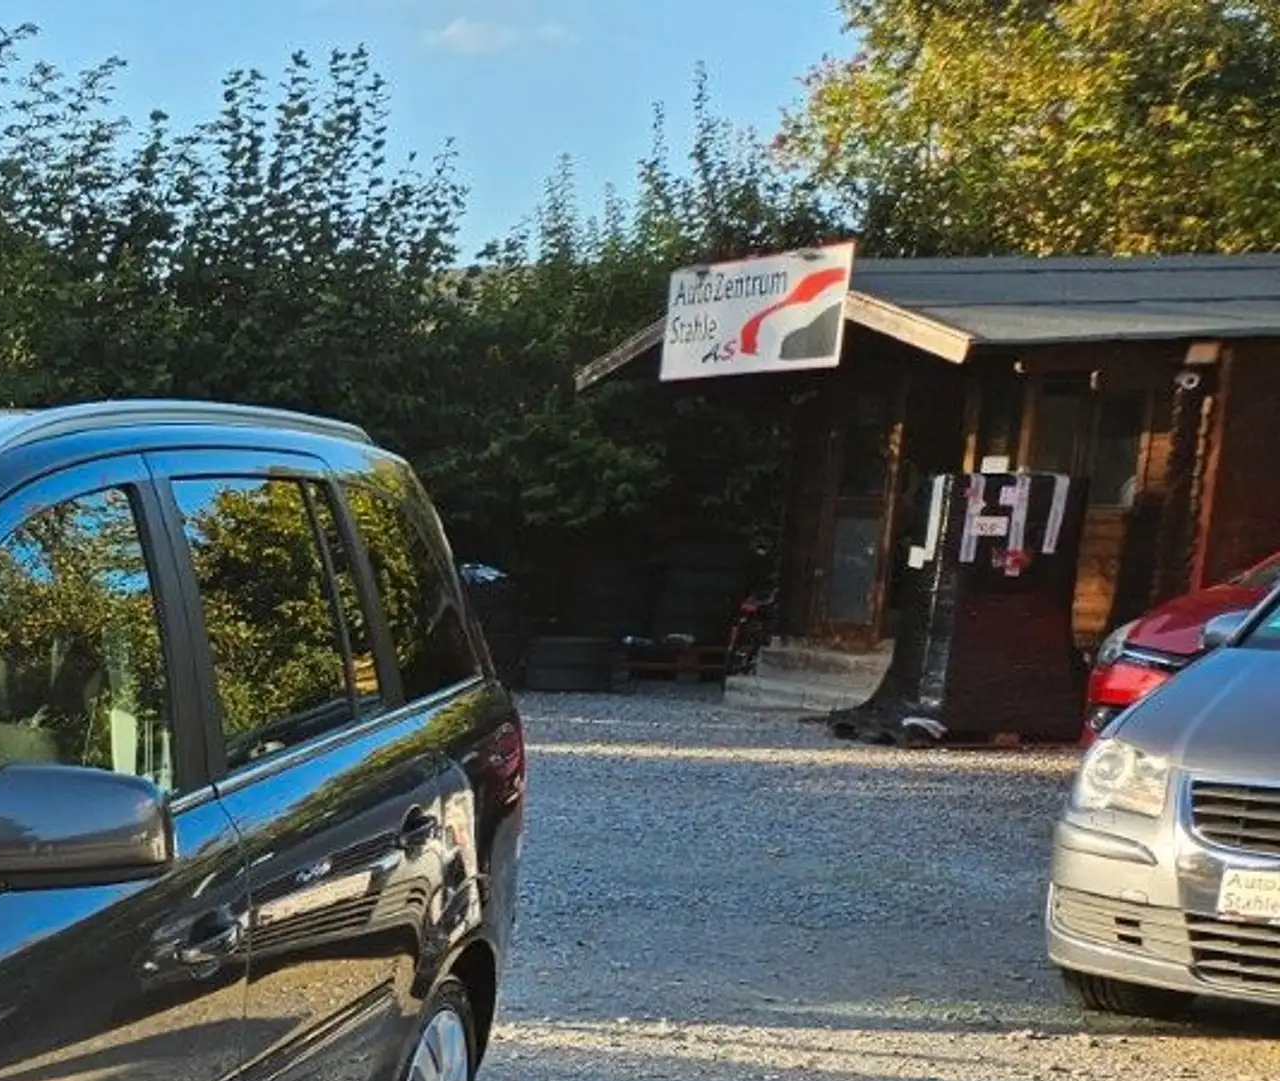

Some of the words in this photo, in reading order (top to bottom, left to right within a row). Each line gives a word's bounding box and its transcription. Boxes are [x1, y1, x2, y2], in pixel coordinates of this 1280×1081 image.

[674, 271, 788, 306] AutoZentrum
[669, 313, 717, 344] Stahle
[701, 339, 737, 363] AS
